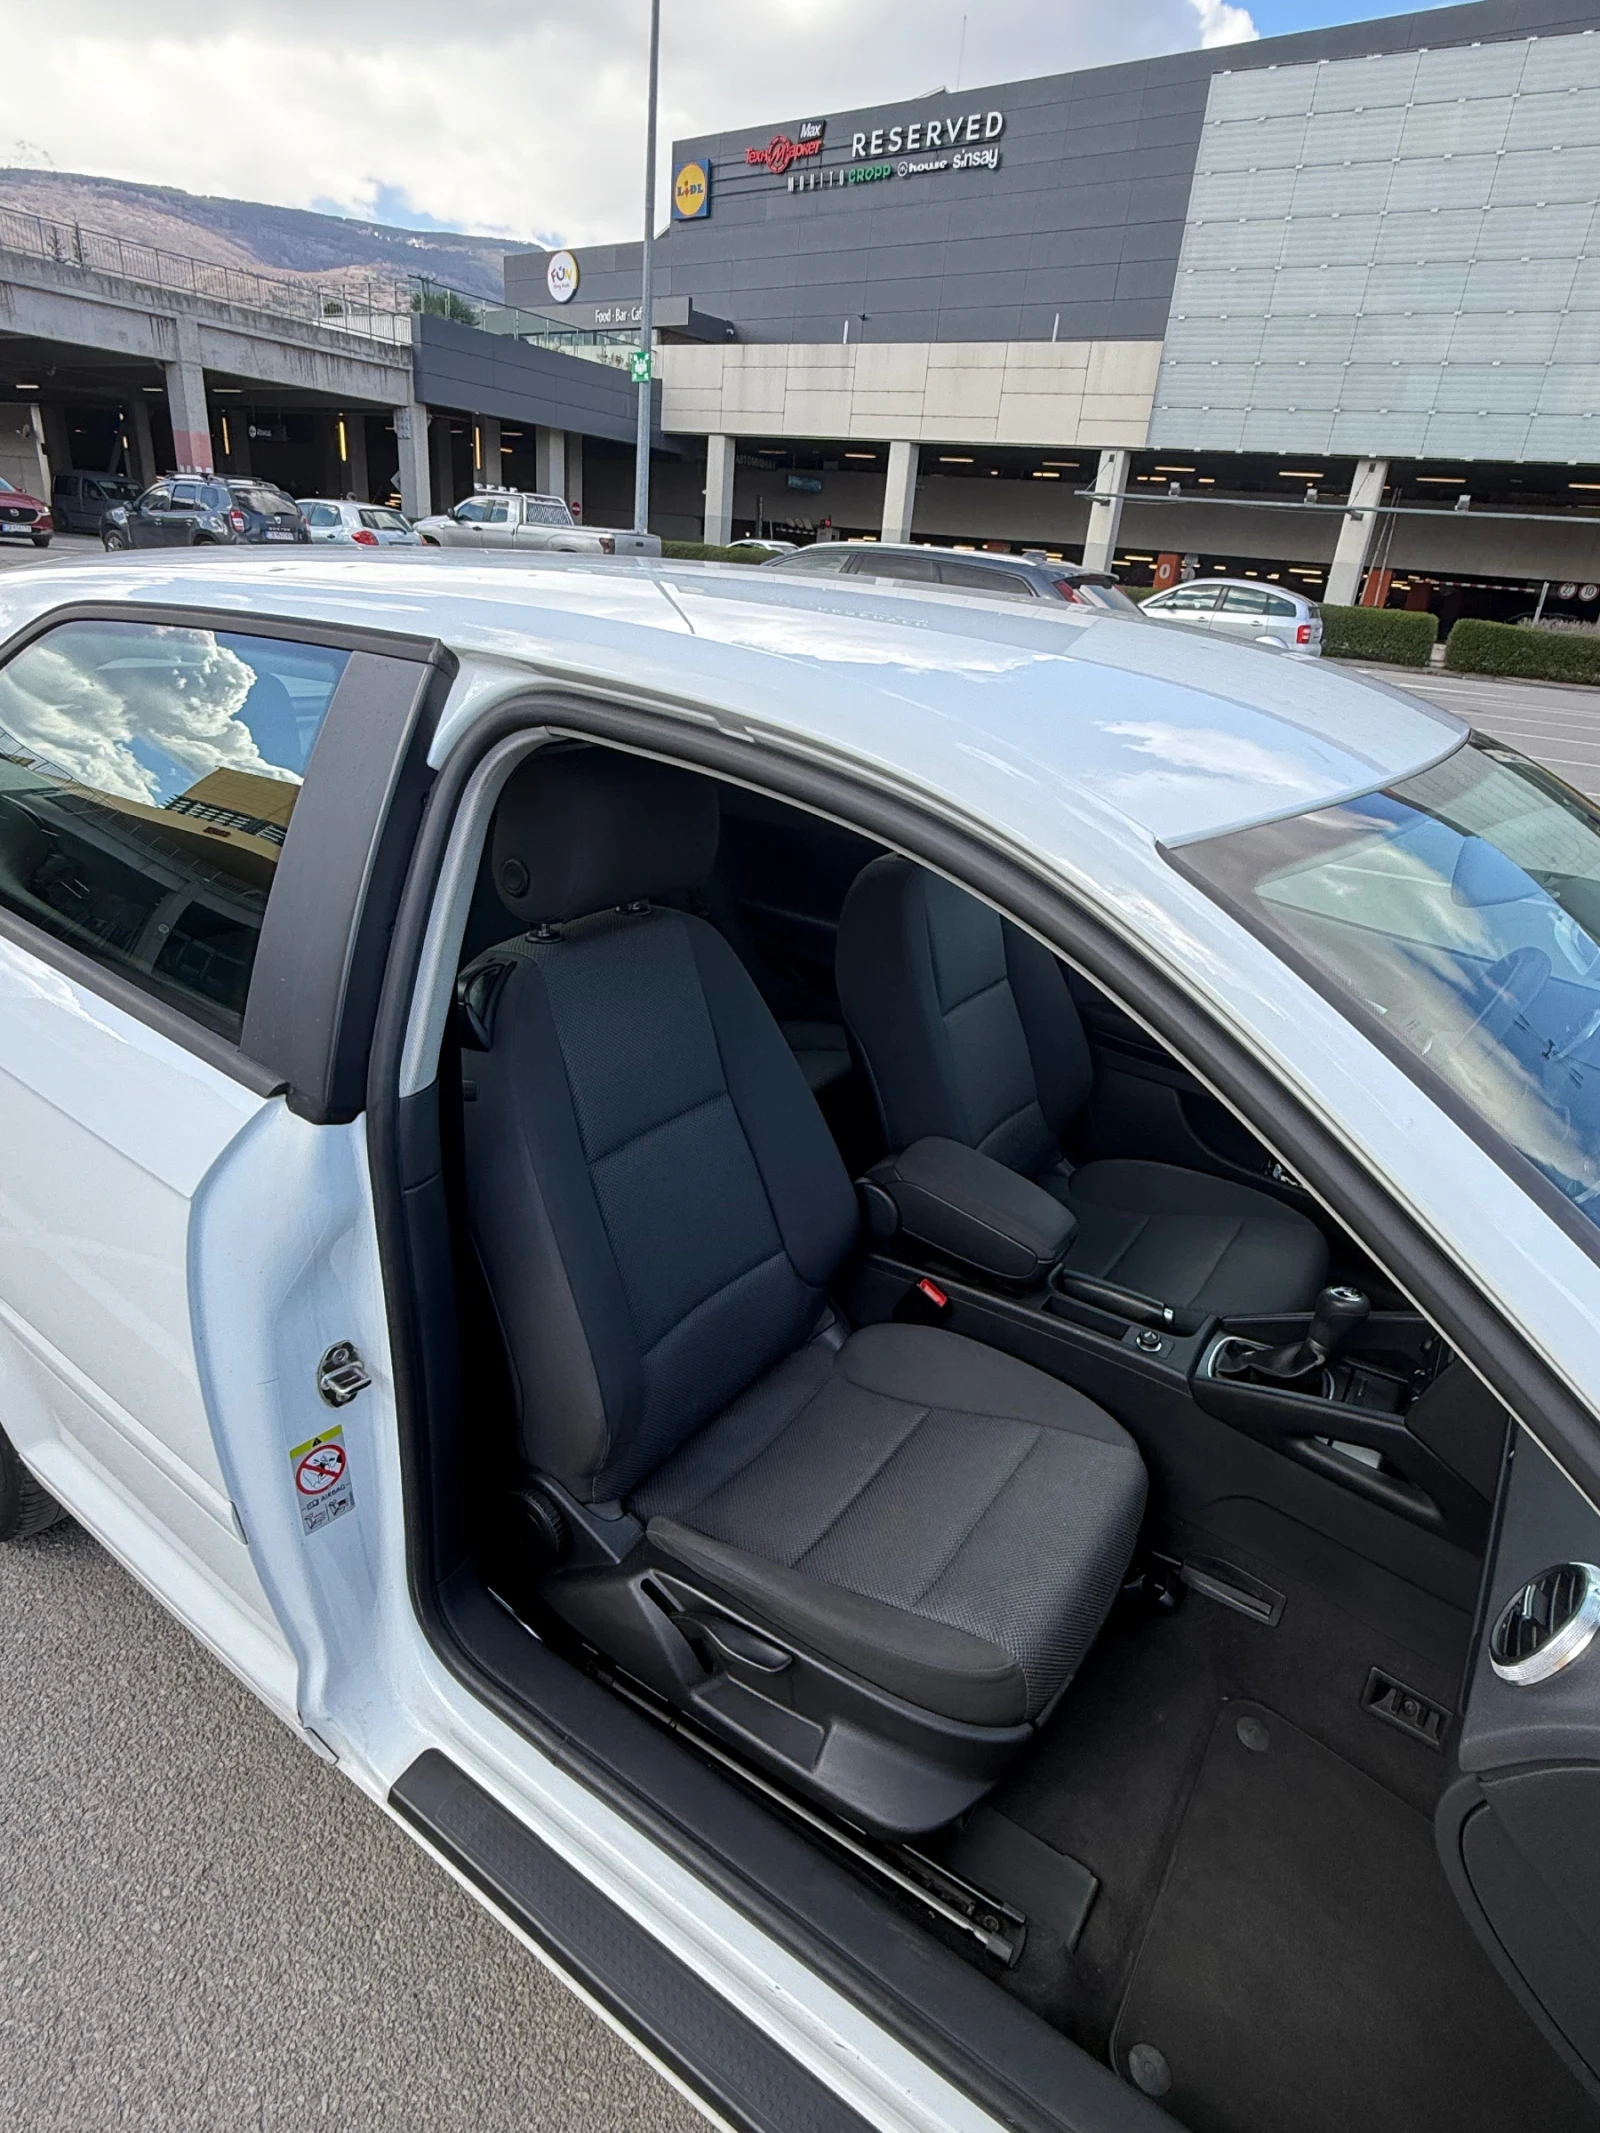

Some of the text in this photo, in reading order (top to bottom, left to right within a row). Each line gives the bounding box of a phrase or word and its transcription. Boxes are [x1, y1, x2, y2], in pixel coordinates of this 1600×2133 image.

[800, 122, 821, 138] Max
[852, 111, 1003, 157] RESERVED
[848, 164, 892, 184] CROPP
[908, 159, 948, 173] house
[953, 148, 999, 169] sinsay
[595, 306, 643, 323] Food Bar Caf
[1584, 586, 1595, 596] 10
[320, 1484, 346, 1501] AIRBAG
